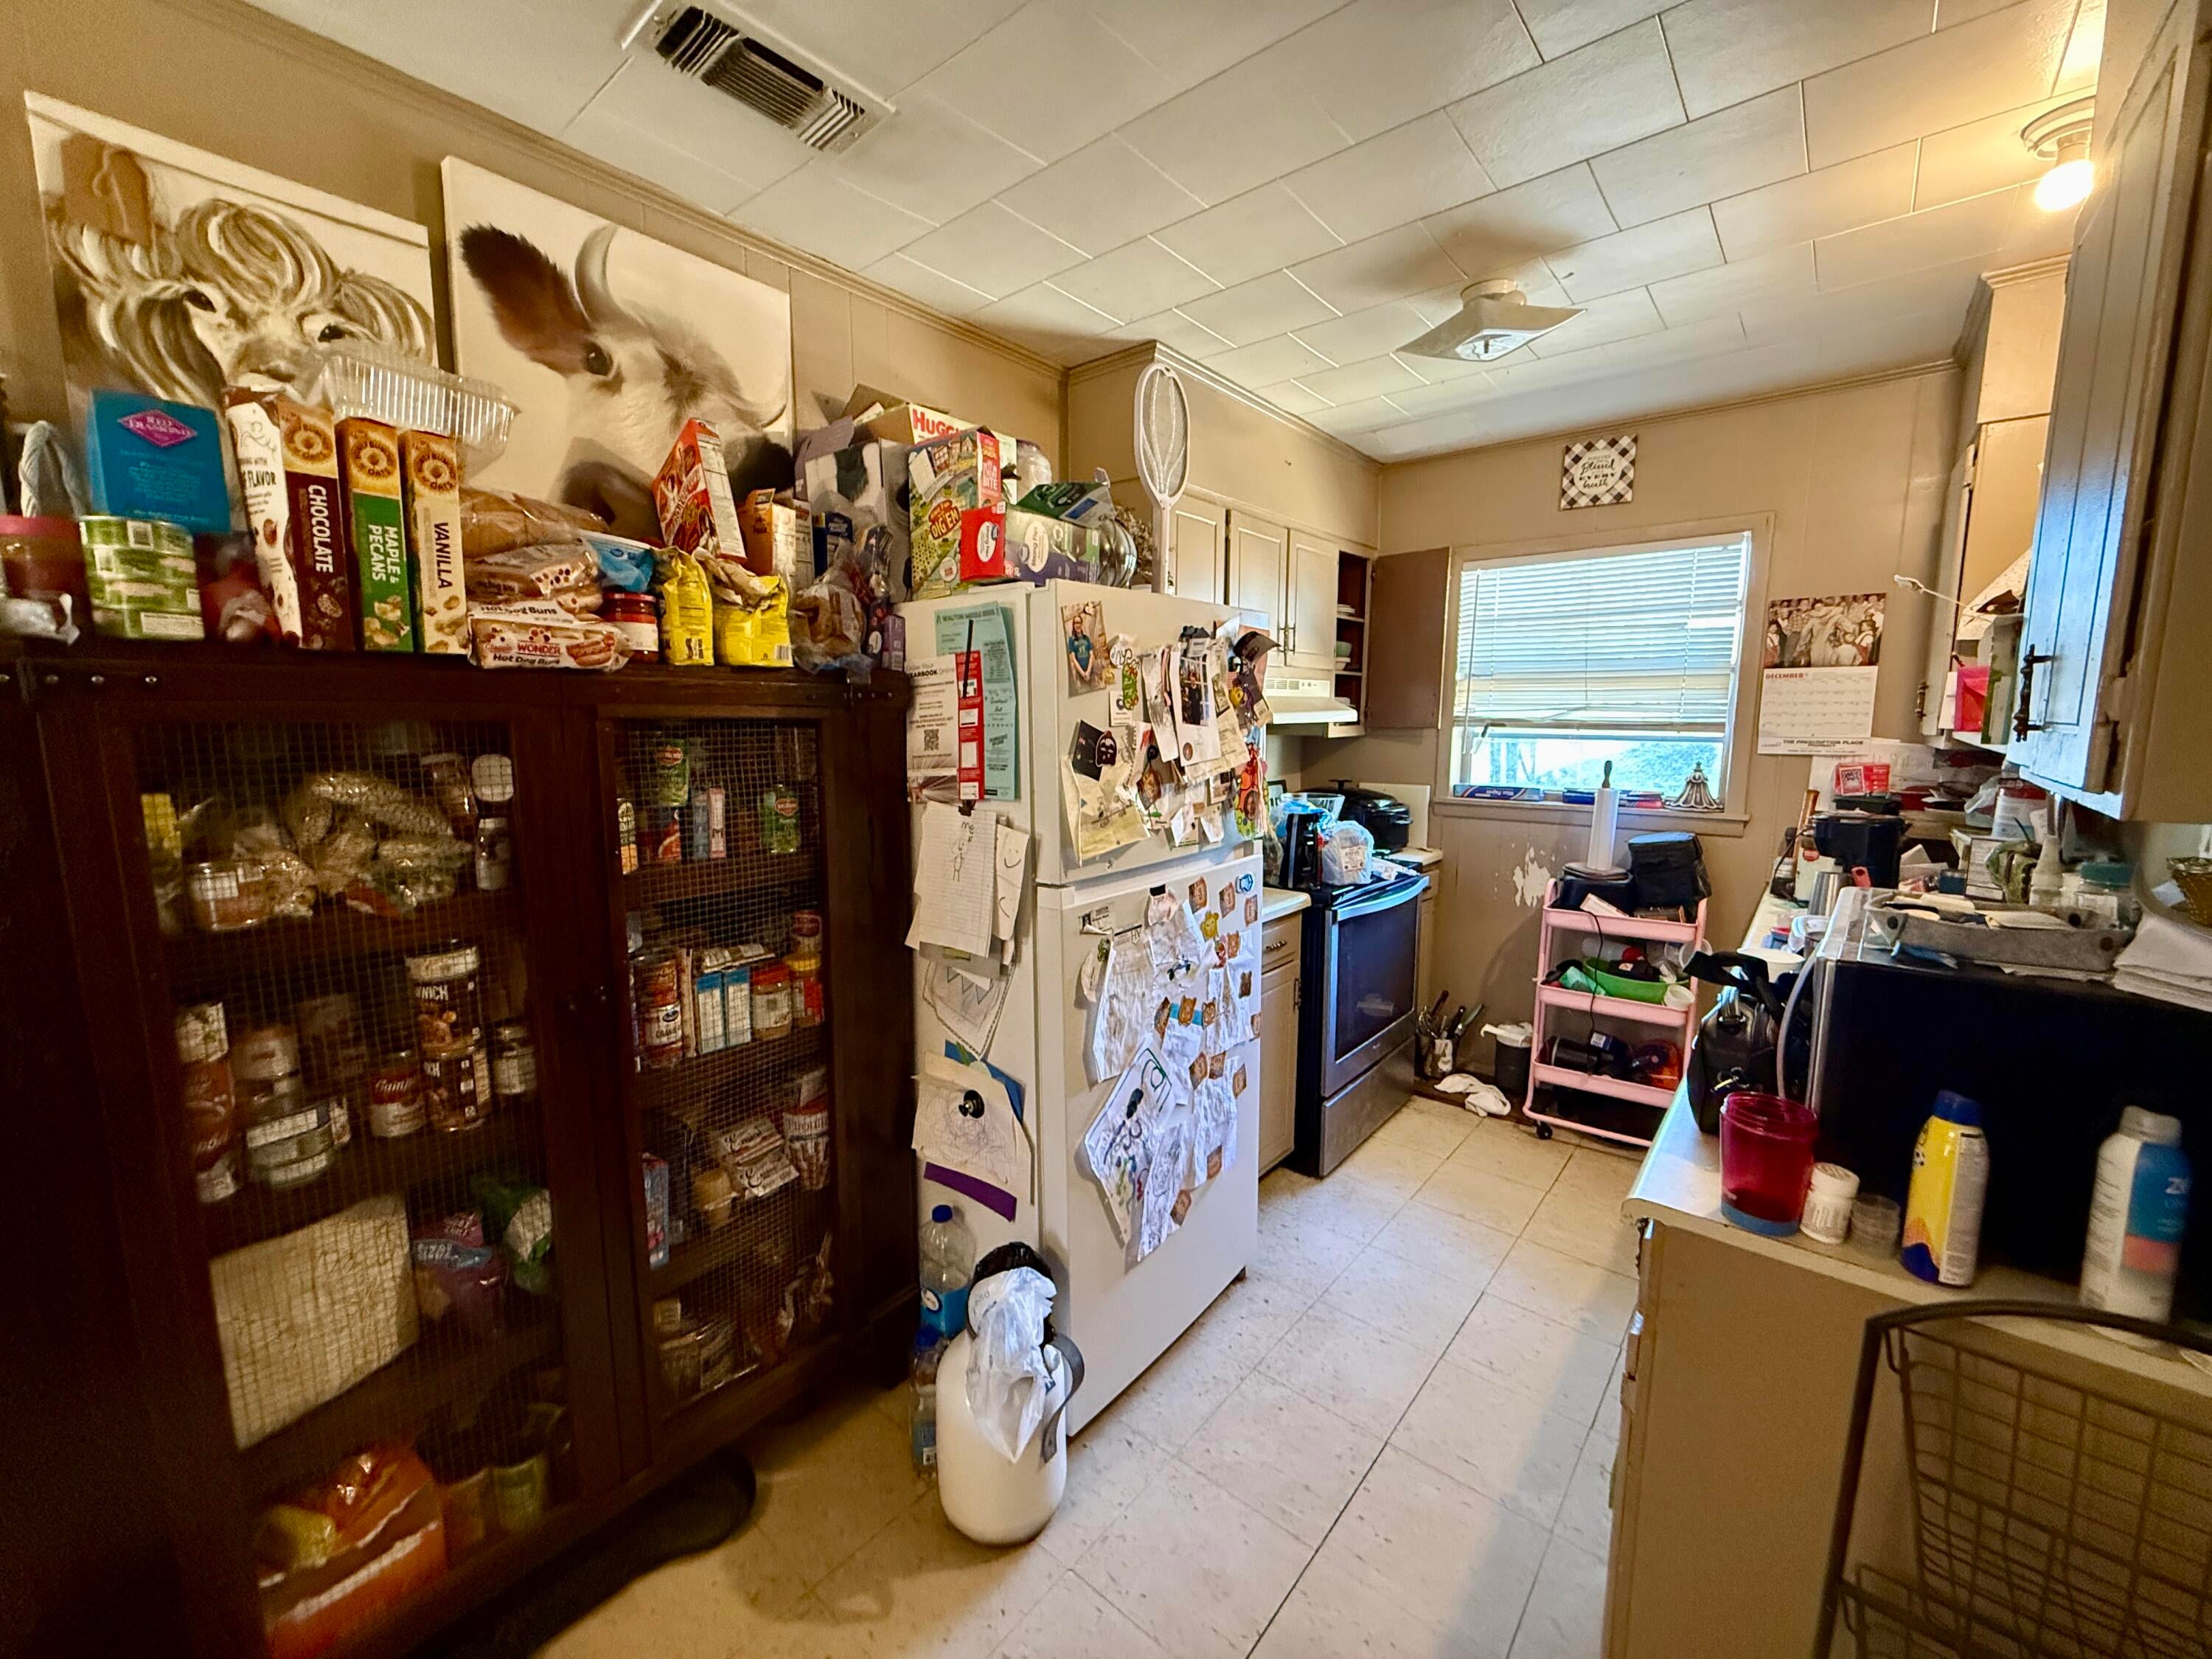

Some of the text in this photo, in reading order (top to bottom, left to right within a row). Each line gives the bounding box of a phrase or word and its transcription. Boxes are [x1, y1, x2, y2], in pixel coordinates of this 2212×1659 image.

[912, 408, 959, 437] HUGG
[247, 470, 276, 487] FLAVOR
[307, 484, 333, 573] CHOCOLATE
[369, 524, 386, 582] PECANS
[383, 525, 400, 574] MAPLE
[434, 522, 453, 589] VANILLA
[493, 653, 514, 663] Hot
[517, 643, 560, 654] WONDER
[908, 669, 938, 678] EARBOOK
